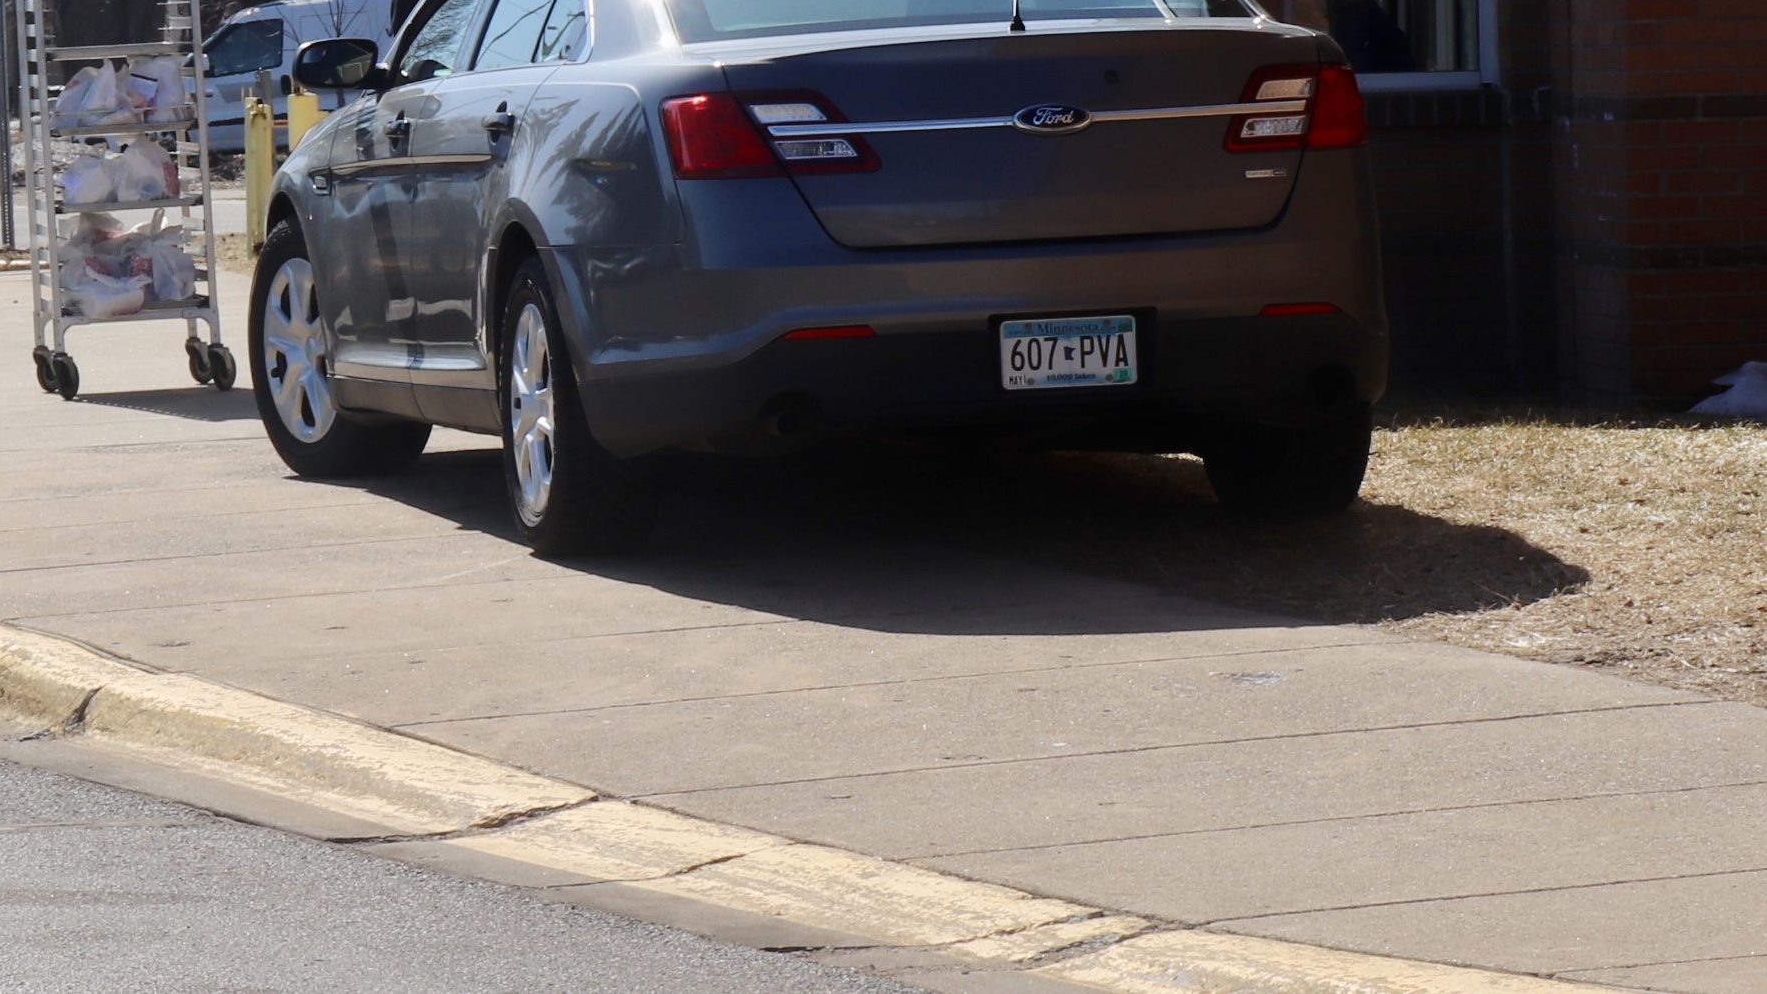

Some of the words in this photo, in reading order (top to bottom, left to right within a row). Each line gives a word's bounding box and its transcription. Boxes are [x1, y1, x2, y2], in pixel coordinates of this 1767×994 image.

[1032, 107, 1074, 125] Ford
[1037, 322, 1100, 335] Minnesota
[1010, 337, 1059, 372] 607
[1079, 334, 1129, 368] PVA
[1008, 375, 1023, 386] MAY
[1046, 373, 1072, 381] 10,000
[1074, 372, 1096, 380] lakes
